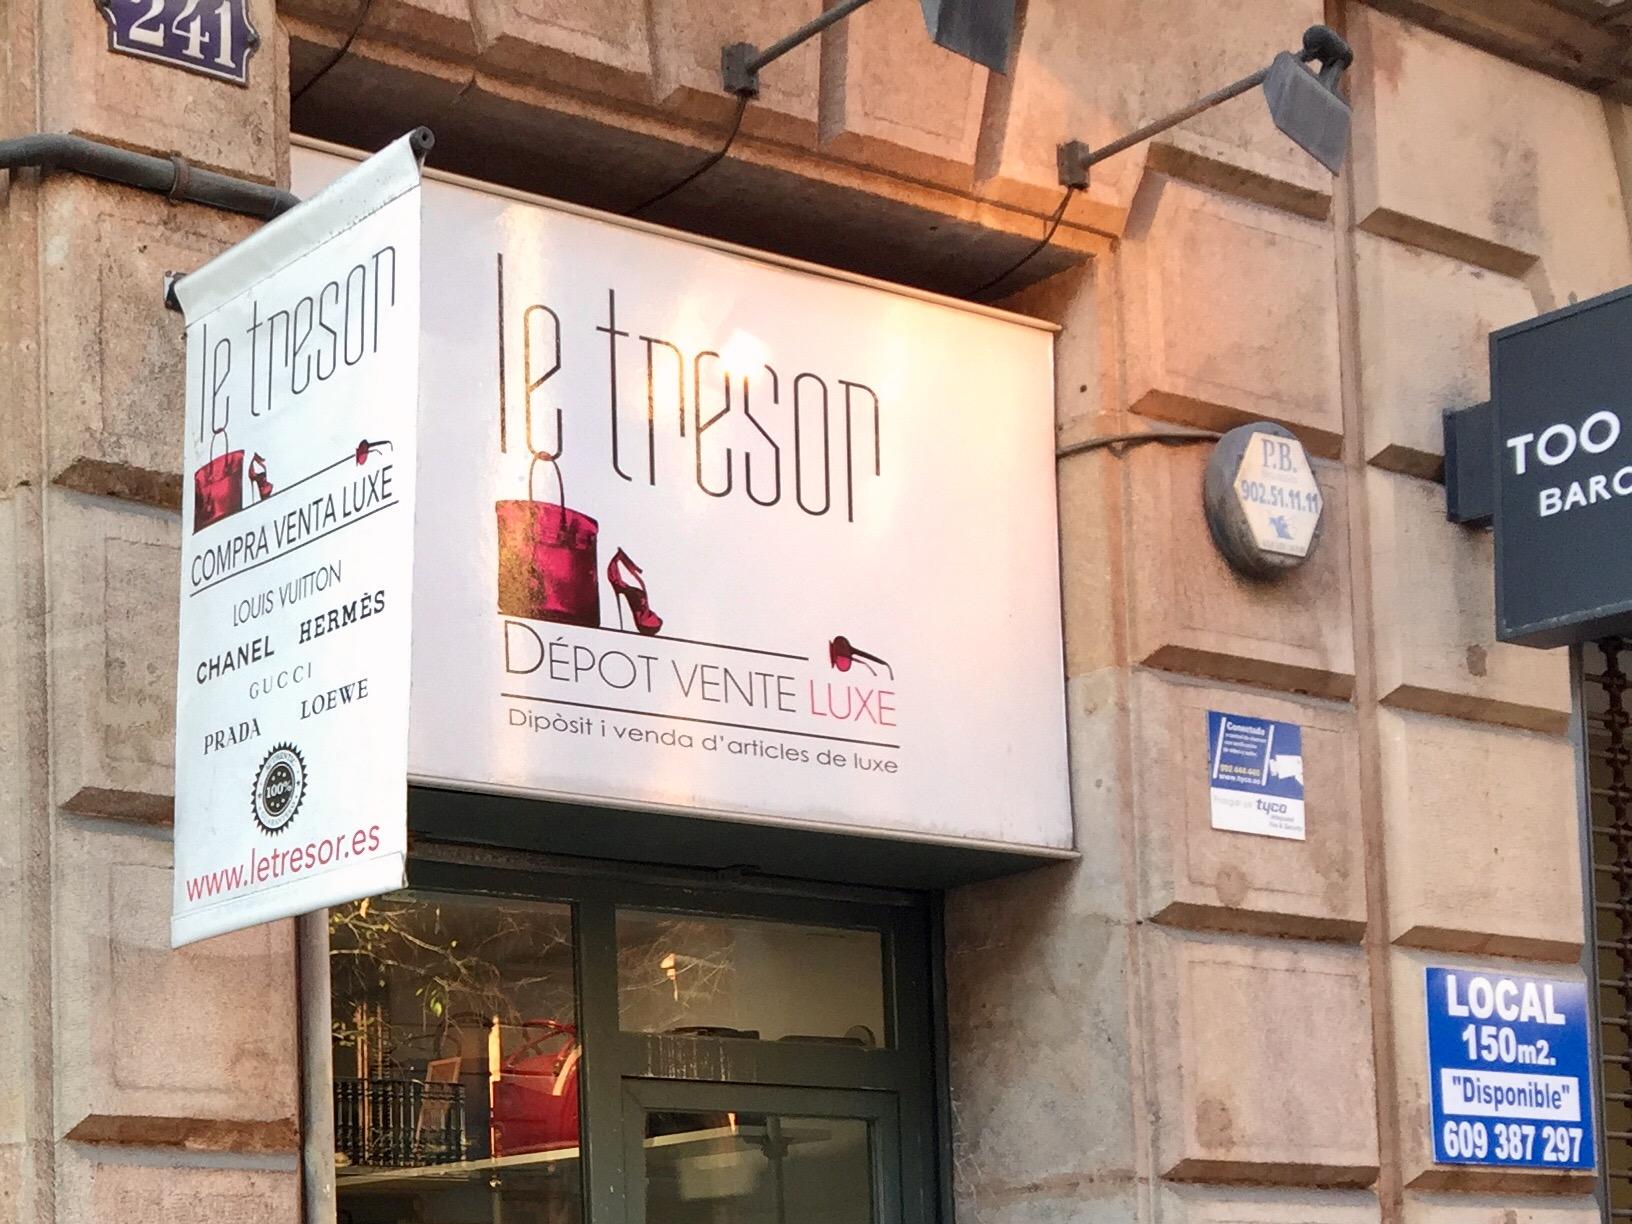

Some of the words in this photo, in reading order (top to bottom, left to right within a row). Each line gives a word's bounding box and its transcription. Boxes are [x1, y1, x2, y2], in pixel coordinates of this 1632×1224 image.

[128, 0, 236, 68] 241
[497, 252, 564, 462] le
[200, 323, 231, 443] le
[1261, 438, 1298, 474] P.B.
[1506, 410, 1622, 476] TOO
[191, 525, 269, 587] COMPRA
[273, 493, 337, 549] VENTA
[342, 464, 393, 519] LUXE
[233, 589, 274, 627] LOUIS
[279, 559, 341, 608] VUITTON
[196, 635, 275, 684] CHANEL
[249, 662, 312, 699] GUCCI
[300, 678, 369, 720] LOEWE
[671, 658, 797, 714] VENTE
[809, 679, 898, 728] LUXE
[203, 718, 261, 755] PRADA
[508, 708, 594, 738] Dipòsit
[600, 719, 607, 739] i
[613, 723, 694, 750] venda
[701, 734, 810, 766] d'articles
[816, 748, 848, 768] de
[853, 751, 899, 775] luxe
[266, 780, 292, 799] 100%
[1256, 799, 1288, 816] tyco
[186, 825, 381, 902] www.letresor.es
[1446, 974, 1566, 1026] LOCAL
[1461, 1023, 1557, 1066] 150m2.
[1452, 1075, 1571, 1112] "Disponible"
[1443, 1120, 1489, 1160] 609
[1493, 1123, 1536, 1161] 387
[1541, 1126, 1584, 1163] 297
